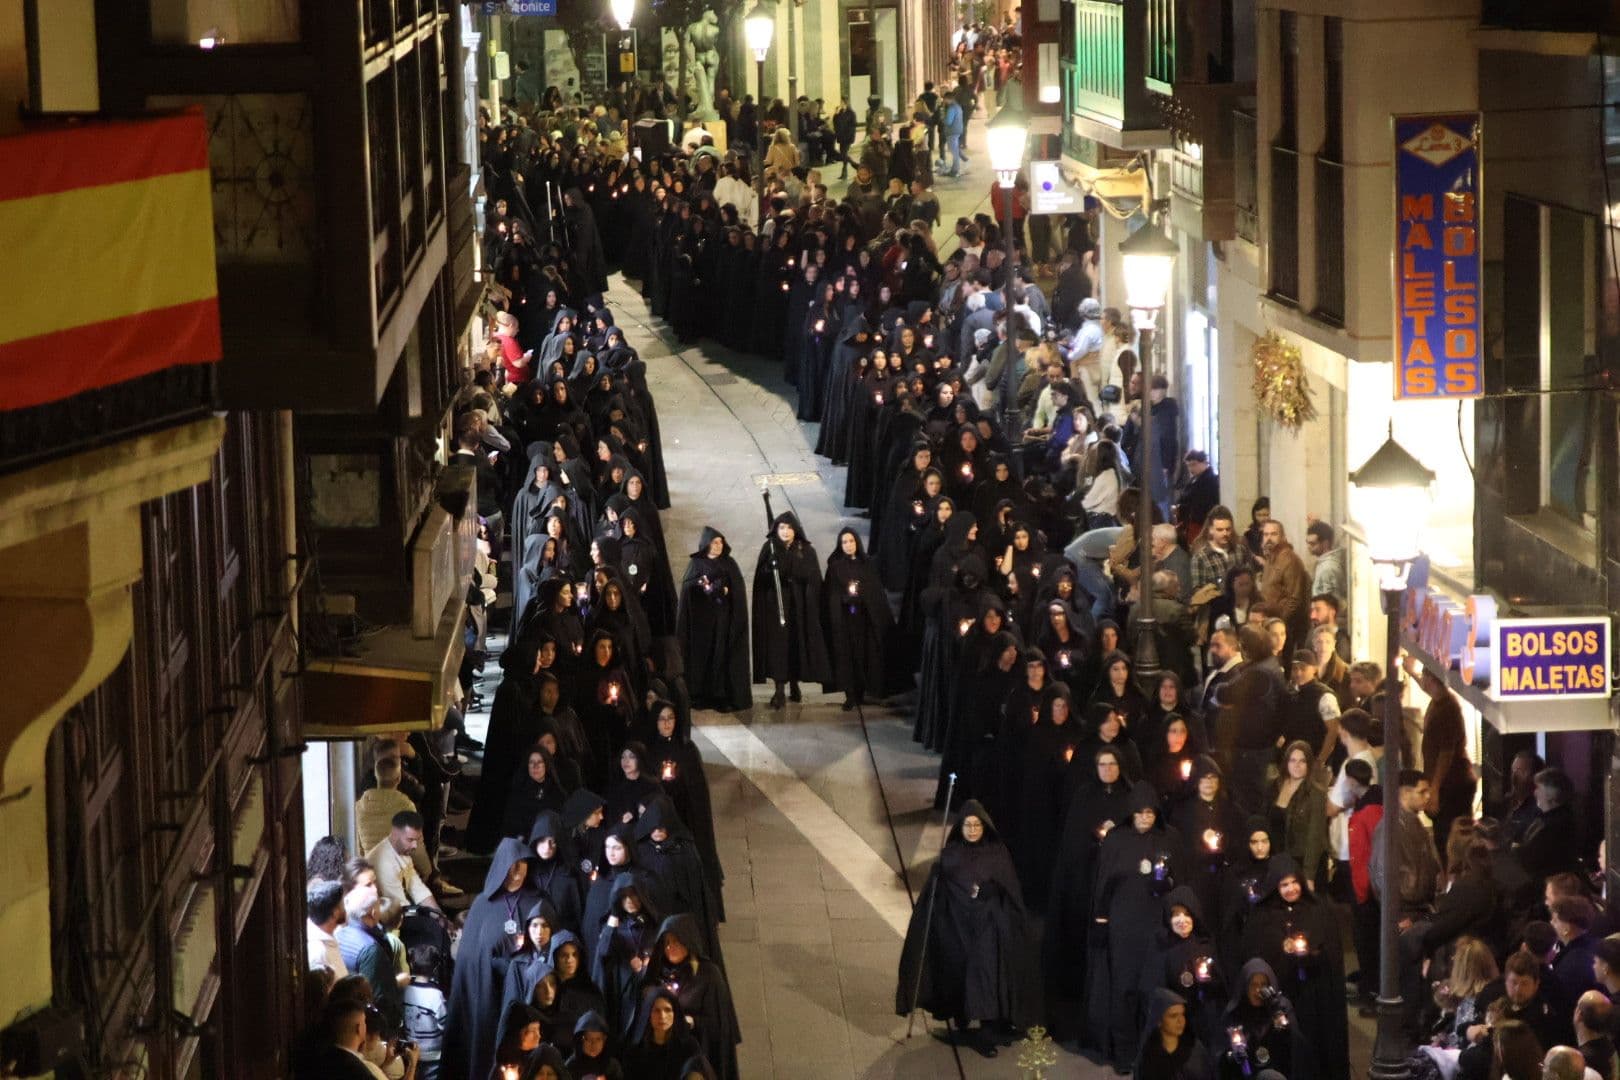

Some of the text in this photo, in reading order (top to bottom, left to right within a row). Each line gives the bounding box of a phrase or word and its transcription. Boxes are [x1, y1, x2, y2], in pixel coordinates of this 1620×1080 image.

[1403, 195, 1436, 394] MALETAS
[1444, 192, 1476, 393] BOLSOS
[1502, 664, 1604, 690] MALETAS
[1507, 631, 1598, 657] BOLSOS
